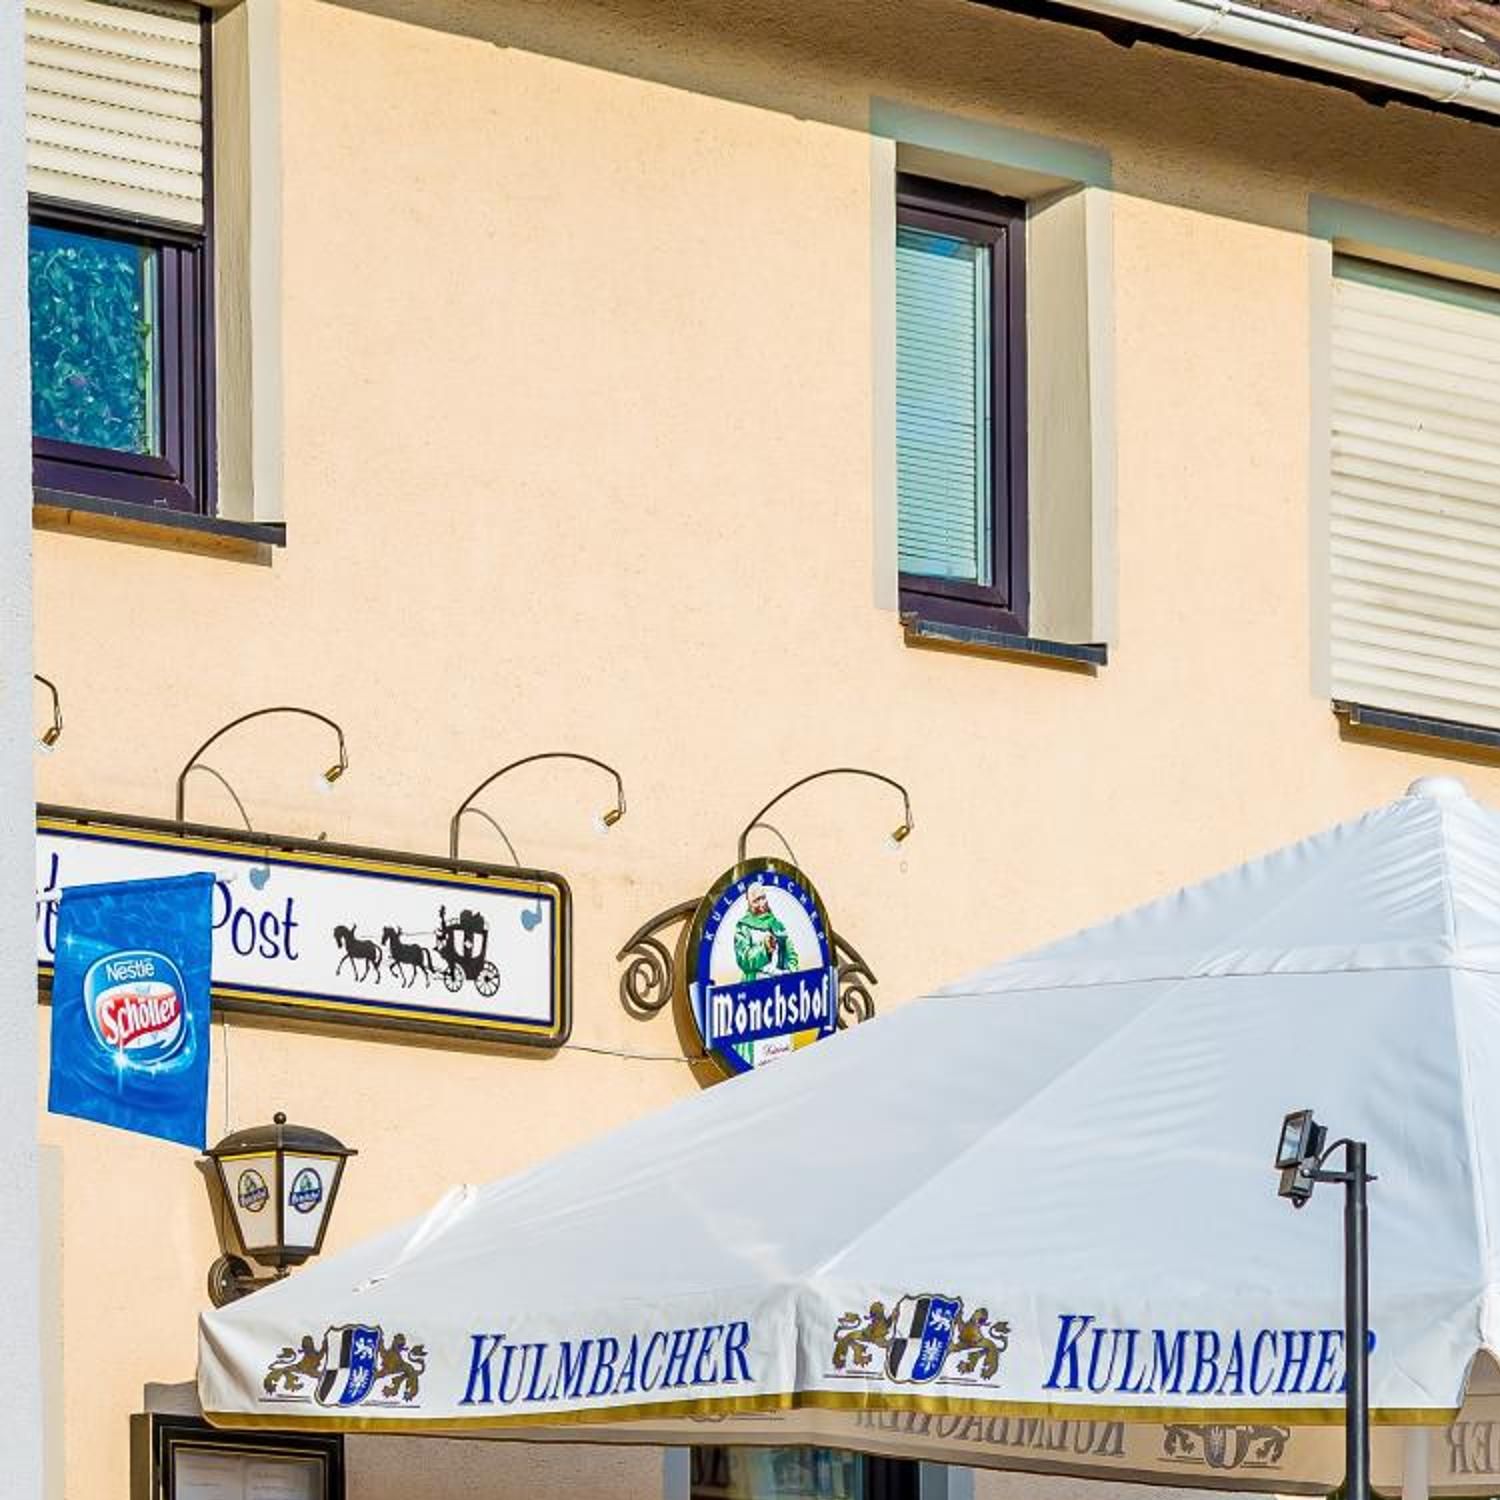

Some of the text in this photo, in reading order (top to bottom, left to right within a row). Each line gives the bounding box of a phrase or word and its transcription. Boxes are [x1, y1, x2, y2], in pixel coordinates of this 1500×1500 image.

[105, 957, 156, 983] Nestlé
[711, 973, 829, 1039] Mönchshof
[458, 1320, 754, 1406] KULMBACHER
